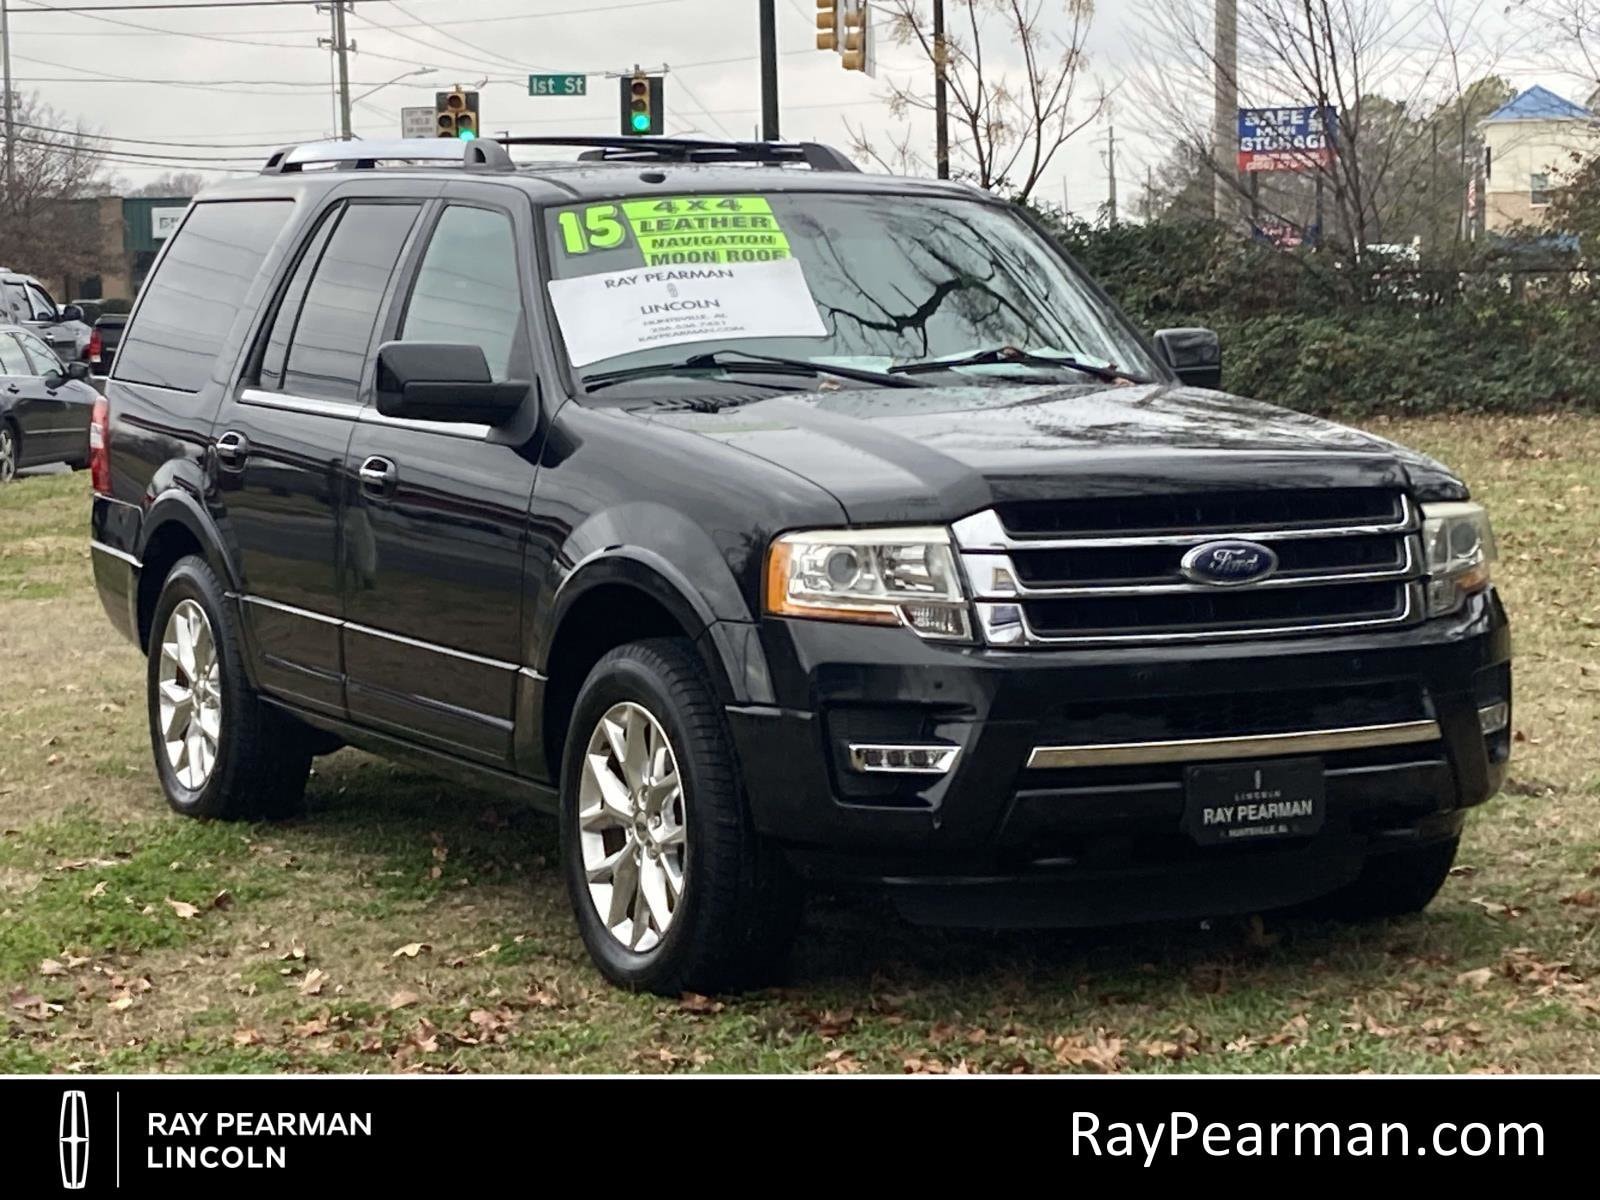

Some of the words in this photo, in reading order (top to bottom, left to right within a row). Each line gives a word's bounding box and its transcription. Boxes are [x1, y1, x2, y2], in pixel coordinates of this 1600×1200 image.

[532, 76, 555, 94] 1st
[564, 76, 584, 94] St
[559, 205, 625, 254] 15
[639, 216, 768, 233] LEATHER
[651, 234, 776, 249] NAVIGATION
[651, 250, 716, 266] MOON
[726, 249, 786, 263] ROOF
[604, 275, 638, 289] RAY
[645, 269, 734, 283] PEARMAN
[640, 299, 720, 315] LINCOLN
[1209, 549, 1258, 572] Ford
[1203, 806, 1234, 825] RAY
[1237, 800, 1313, 822] PEARMAN
